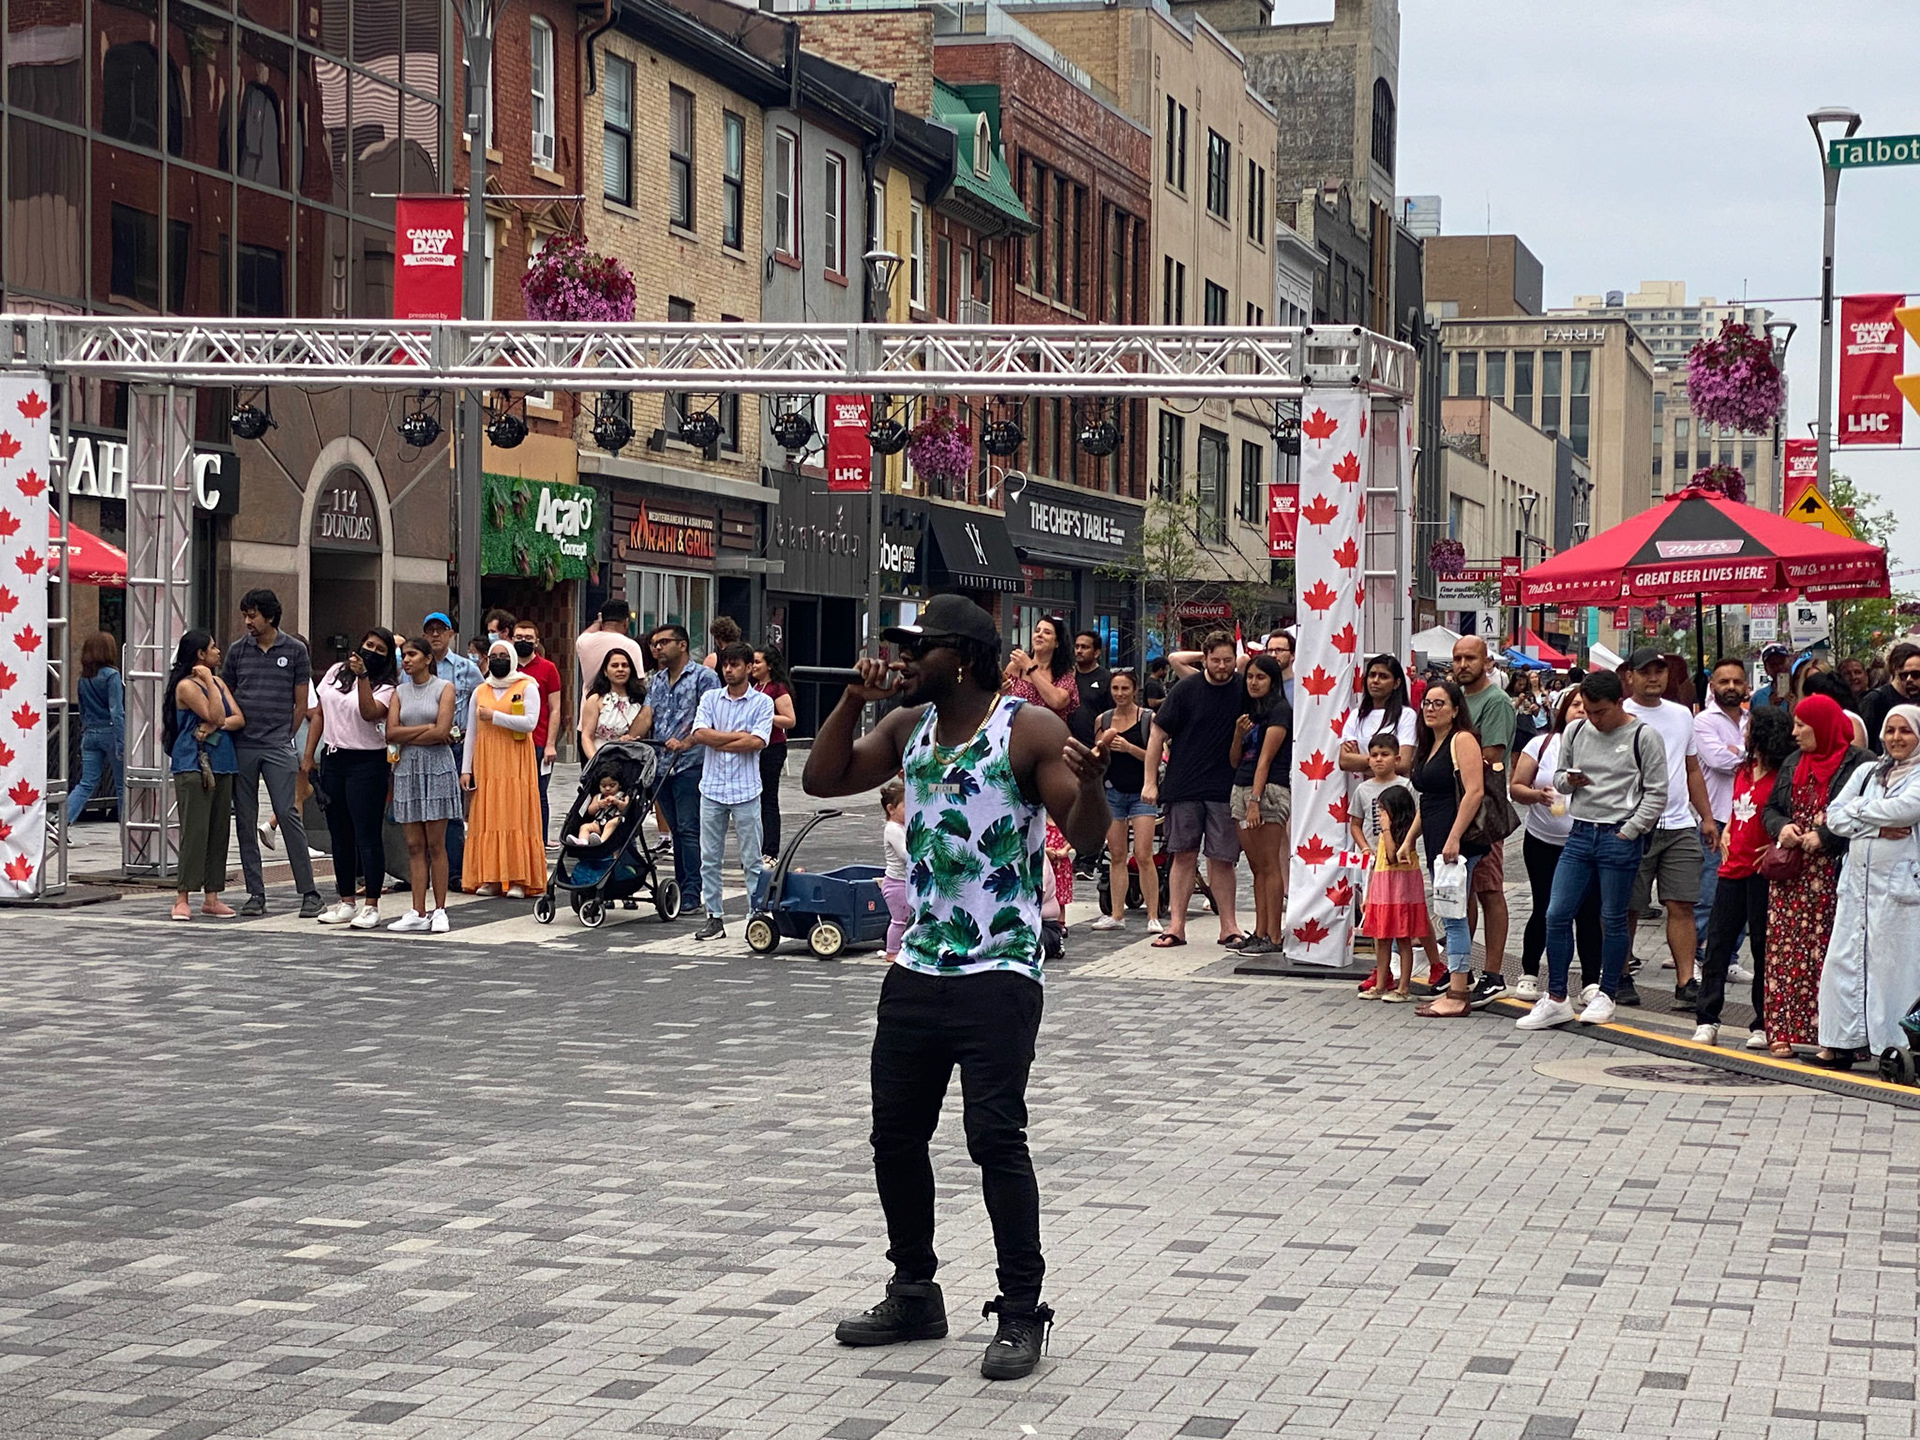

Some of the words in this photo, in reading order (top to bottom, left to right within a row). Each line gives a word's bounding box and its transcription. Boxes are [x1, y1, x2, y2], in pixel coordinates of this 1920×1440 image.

[1836, 139, 1920, 164] Talbot
[407, 229, 454, 241] CANADA
[413, 239, 447, 254] DAY
[1850, 322, 1895, 332] CANADA
[1856, 331, 1889, 344] DAY
[835, 404, 865, 412] CANADA
[839, 410, 862, 419] DAY
[1848, 413, 1890, 432] LHC
[1794, 462, 1815, 470] DAY
[835, 468, 863, 480] LHC
[333, 489, 358, 515] 114
[322, 513, 372, 540] DUNDAS
[1030, 501, 1049, 532] THE
[1049, 506, 1081, 537] CHEF'S
[1082, 512, 1109, 543] TABLE
[560, 538, 587, 561] Concept
[678, 529, 685, 553] &
[685, 528, 714, 558] GRILL
[1273, 540, 1294, 550] LHC
[1820, 561, 1877, 573] BREWERY
[1635, 571, 1671, 586] GREAT
[1672, 569, 1701, 584] BEER
[1702, 567, 1733, 581] LIVES
[1735, 566, 1767, 580] HERE.
[993, 578, 1017, 592] HOUSE
[1557, 580, 1615, 590] BREWERY
